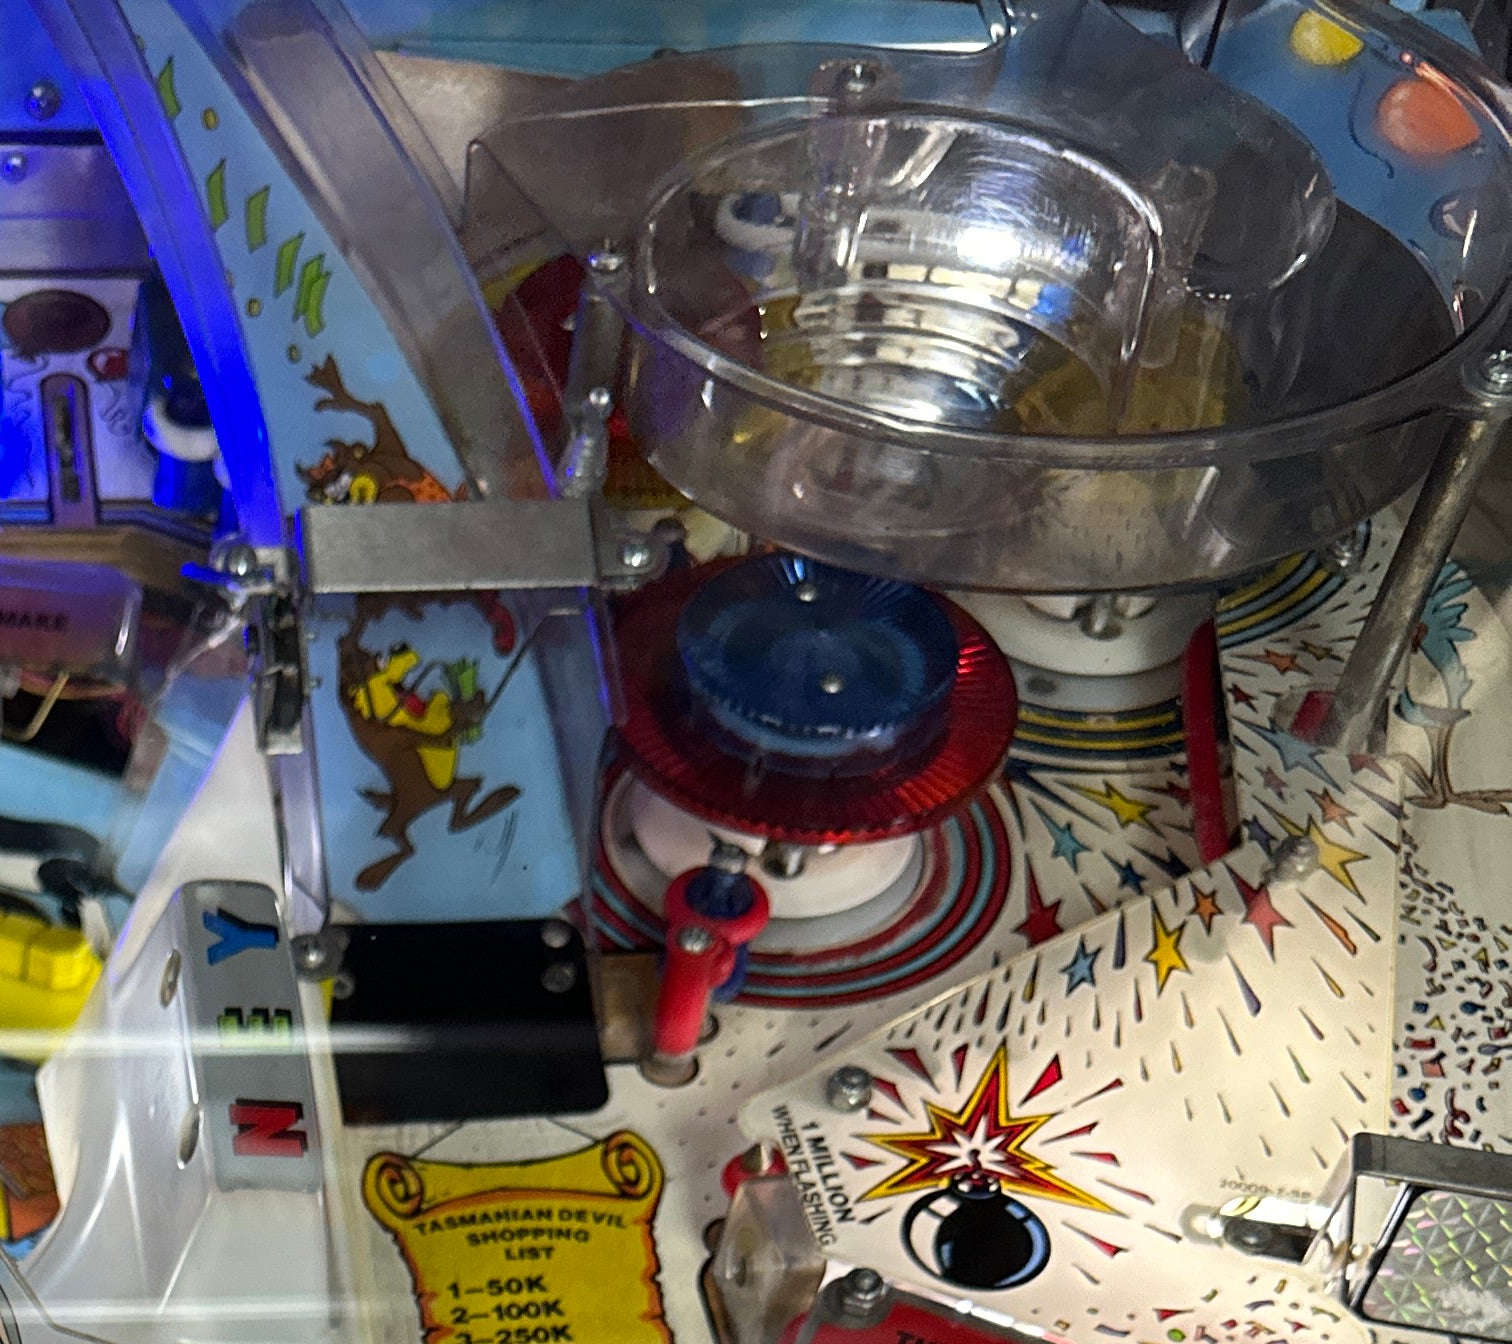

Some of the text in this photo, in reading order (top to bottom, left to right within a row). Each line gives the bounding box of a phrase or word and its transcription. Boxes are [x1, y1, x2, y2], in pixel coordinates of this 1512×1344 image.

[772, 1105, 837, 1246] WHEN FLASHING
[806, 1136, 856, 1223] MILLION
[414, 1207, 627, 1236] TASMANIAN DEVIL
[465, 1227, 591, 1247] SHOPPING
[504, 1246, 555, 1261] LIST
